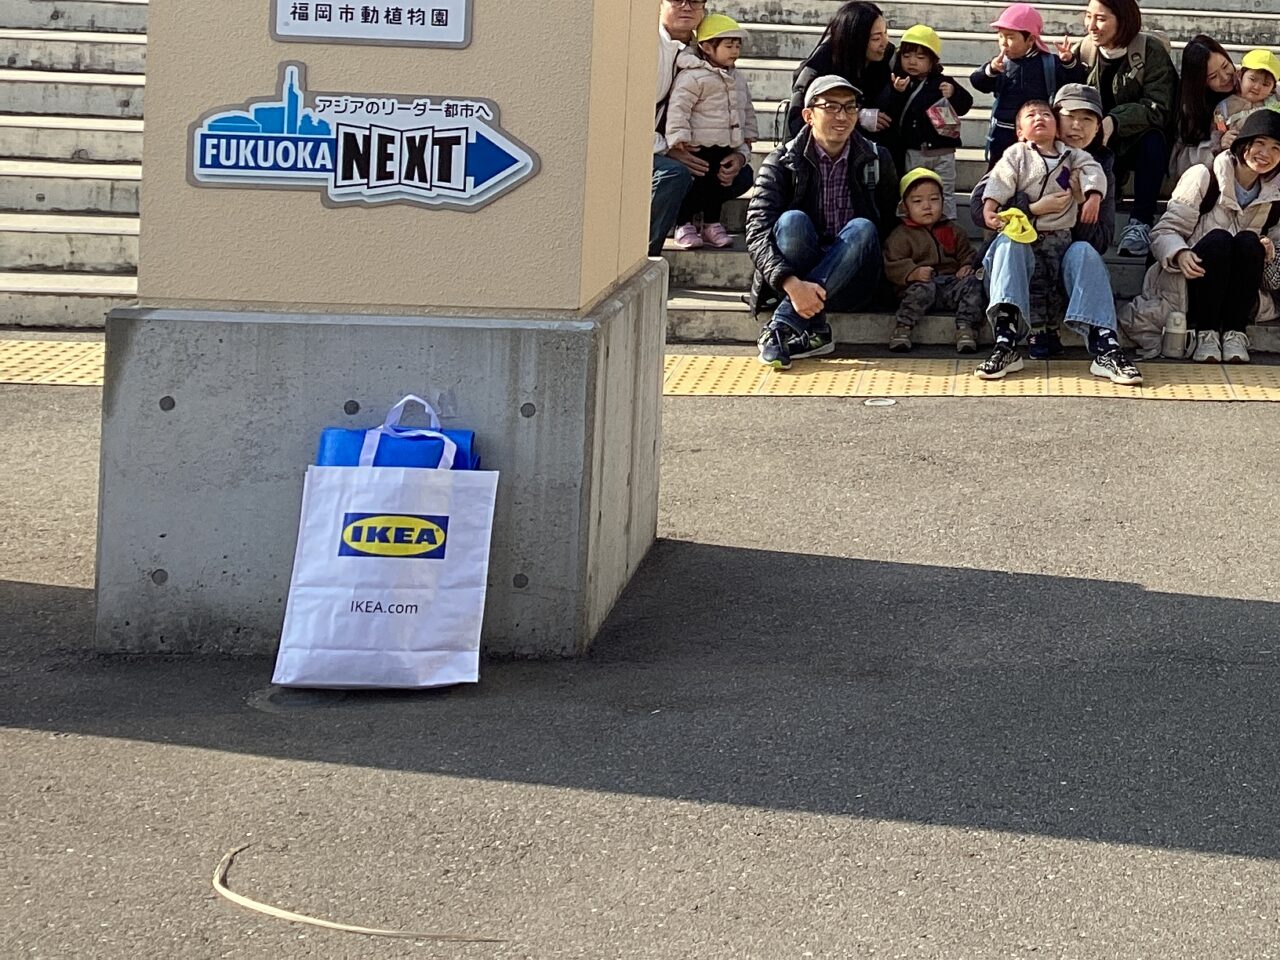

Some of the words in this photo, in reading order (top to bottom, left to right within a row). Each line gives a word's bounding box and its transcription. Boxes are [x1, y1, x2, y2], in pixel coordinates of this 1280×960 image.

[290, 4, 449, 27] 福岡市動植物園
[318, 100, 490, 119] アジアのリーダー都市へ
[205, 138, 332, 169] FUKUOKA
[341, 131, 460, 183] NEXT
[352, 526, 437, 544] IKEA
[351, 600, 418, 614] IKEA.com
